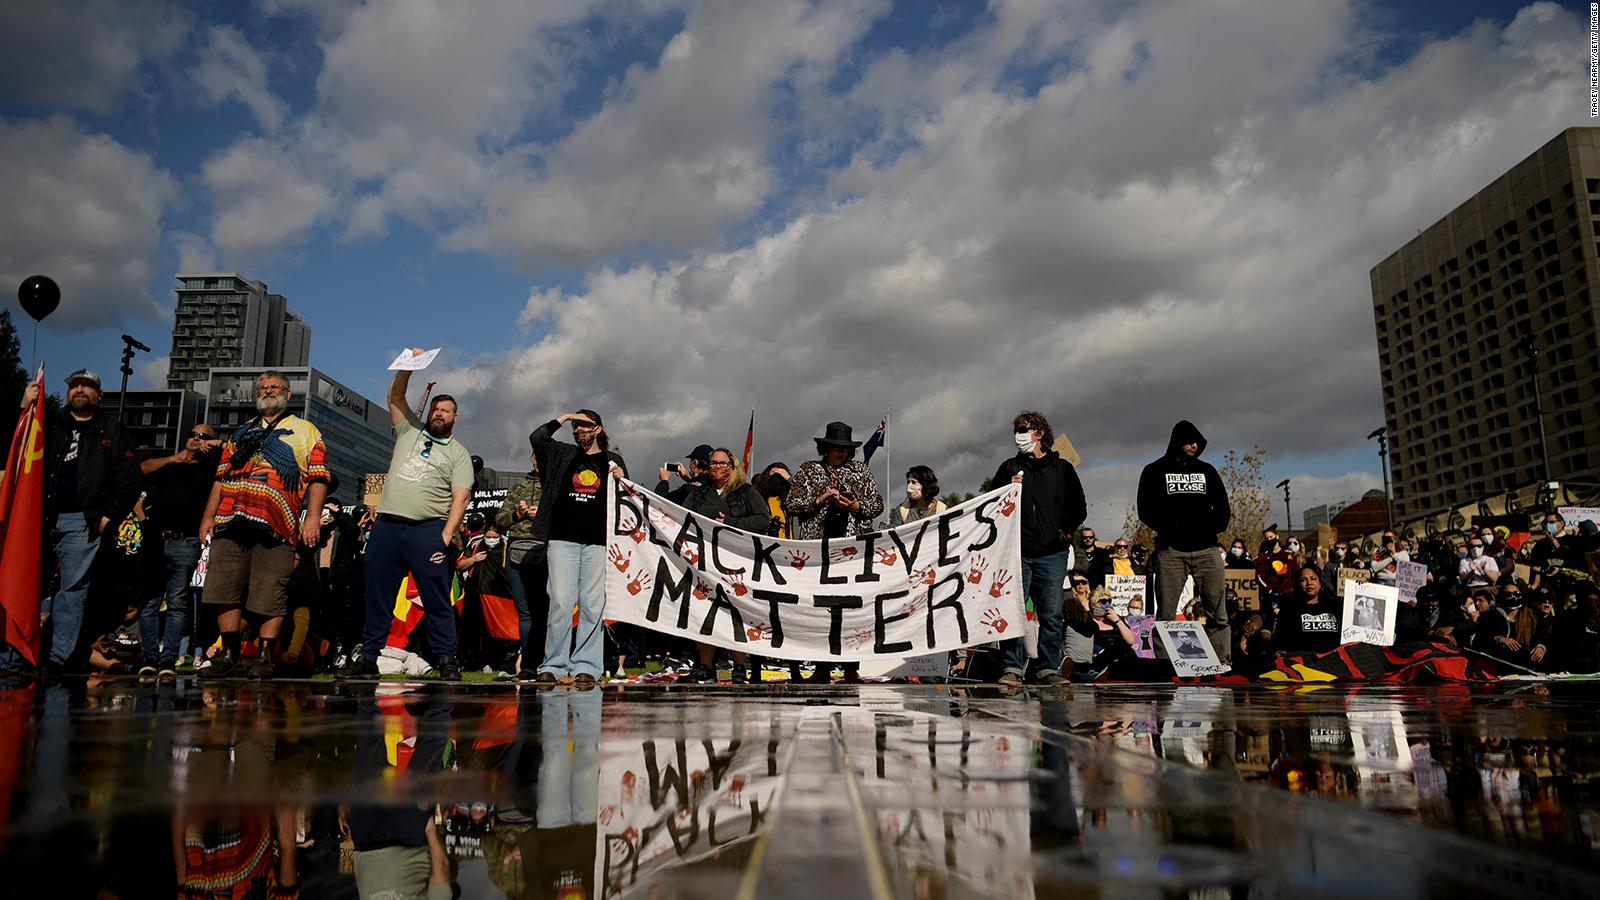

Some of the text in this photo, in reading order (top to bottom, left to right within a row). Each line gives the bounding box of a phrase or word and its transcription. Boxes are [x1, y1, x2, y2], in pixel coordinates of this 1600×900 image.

[1168, 483, 1176, 492] 2
[614, 478, 1000, 585] BLACK LIVES
[1398, 561, 1412, 569] SAY
[1338, 569, 1367, 579] BLACK
[645, 555, 969, 654] MATTER
[1163, 621, 1198, 629] JUSTICE
[1304, 622, 1311, 630] 2
[1343, 627, 1360, 640] FOR
[1190, 664, 1222, 672] GEORGE
